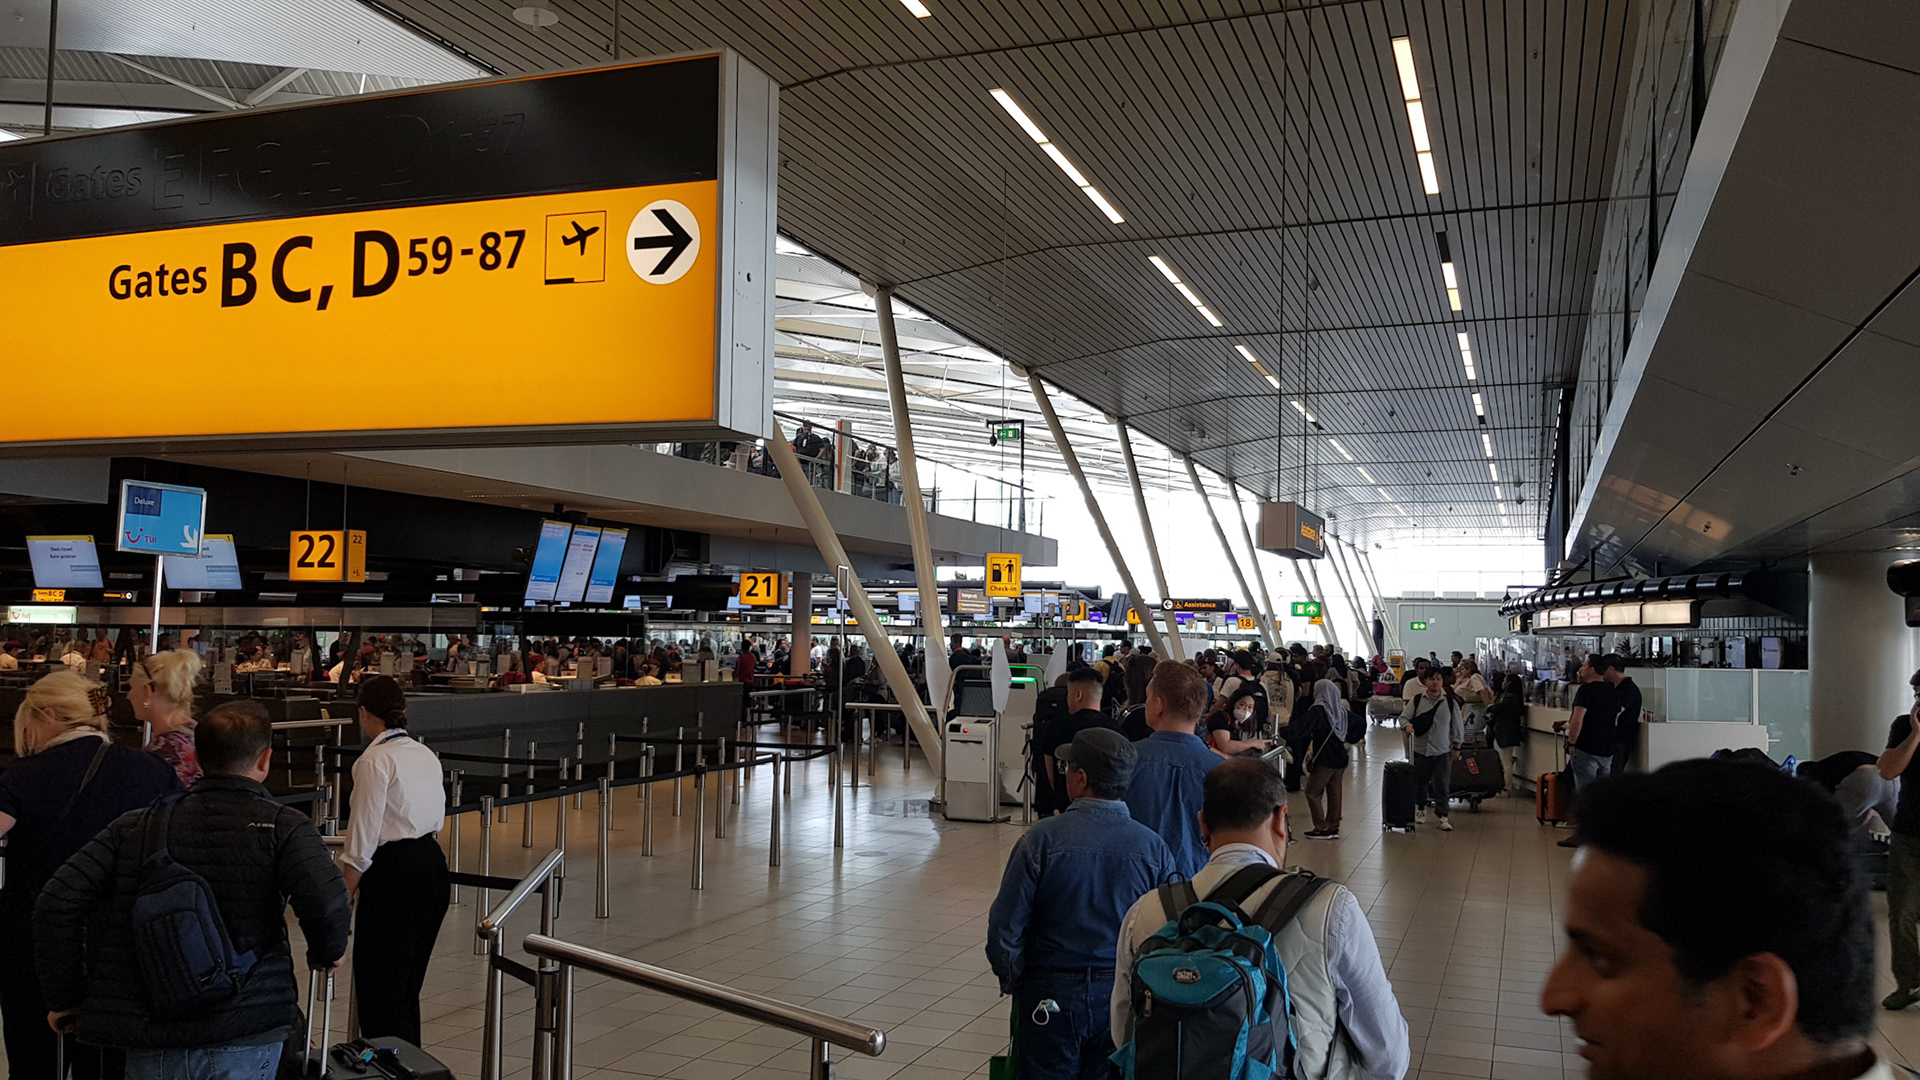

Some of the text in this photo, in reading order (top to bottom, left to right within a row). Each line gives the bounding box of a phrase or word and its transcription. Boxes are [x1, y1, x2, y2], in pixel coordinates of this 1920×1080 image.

[108, 263, 207, 300] Gates
[408, 229, 526, 277] 59-87
[134, 496, 155, 506] Deluxe
[88, 535, 92, 543] 2
[144, 535, 157, 543] TUI
[352, 534, 363, 544] 22
[296, 534, 336, 568] 22
[745, 575, 772, 597] 21
[1240, 618, 1251, 627] 18
